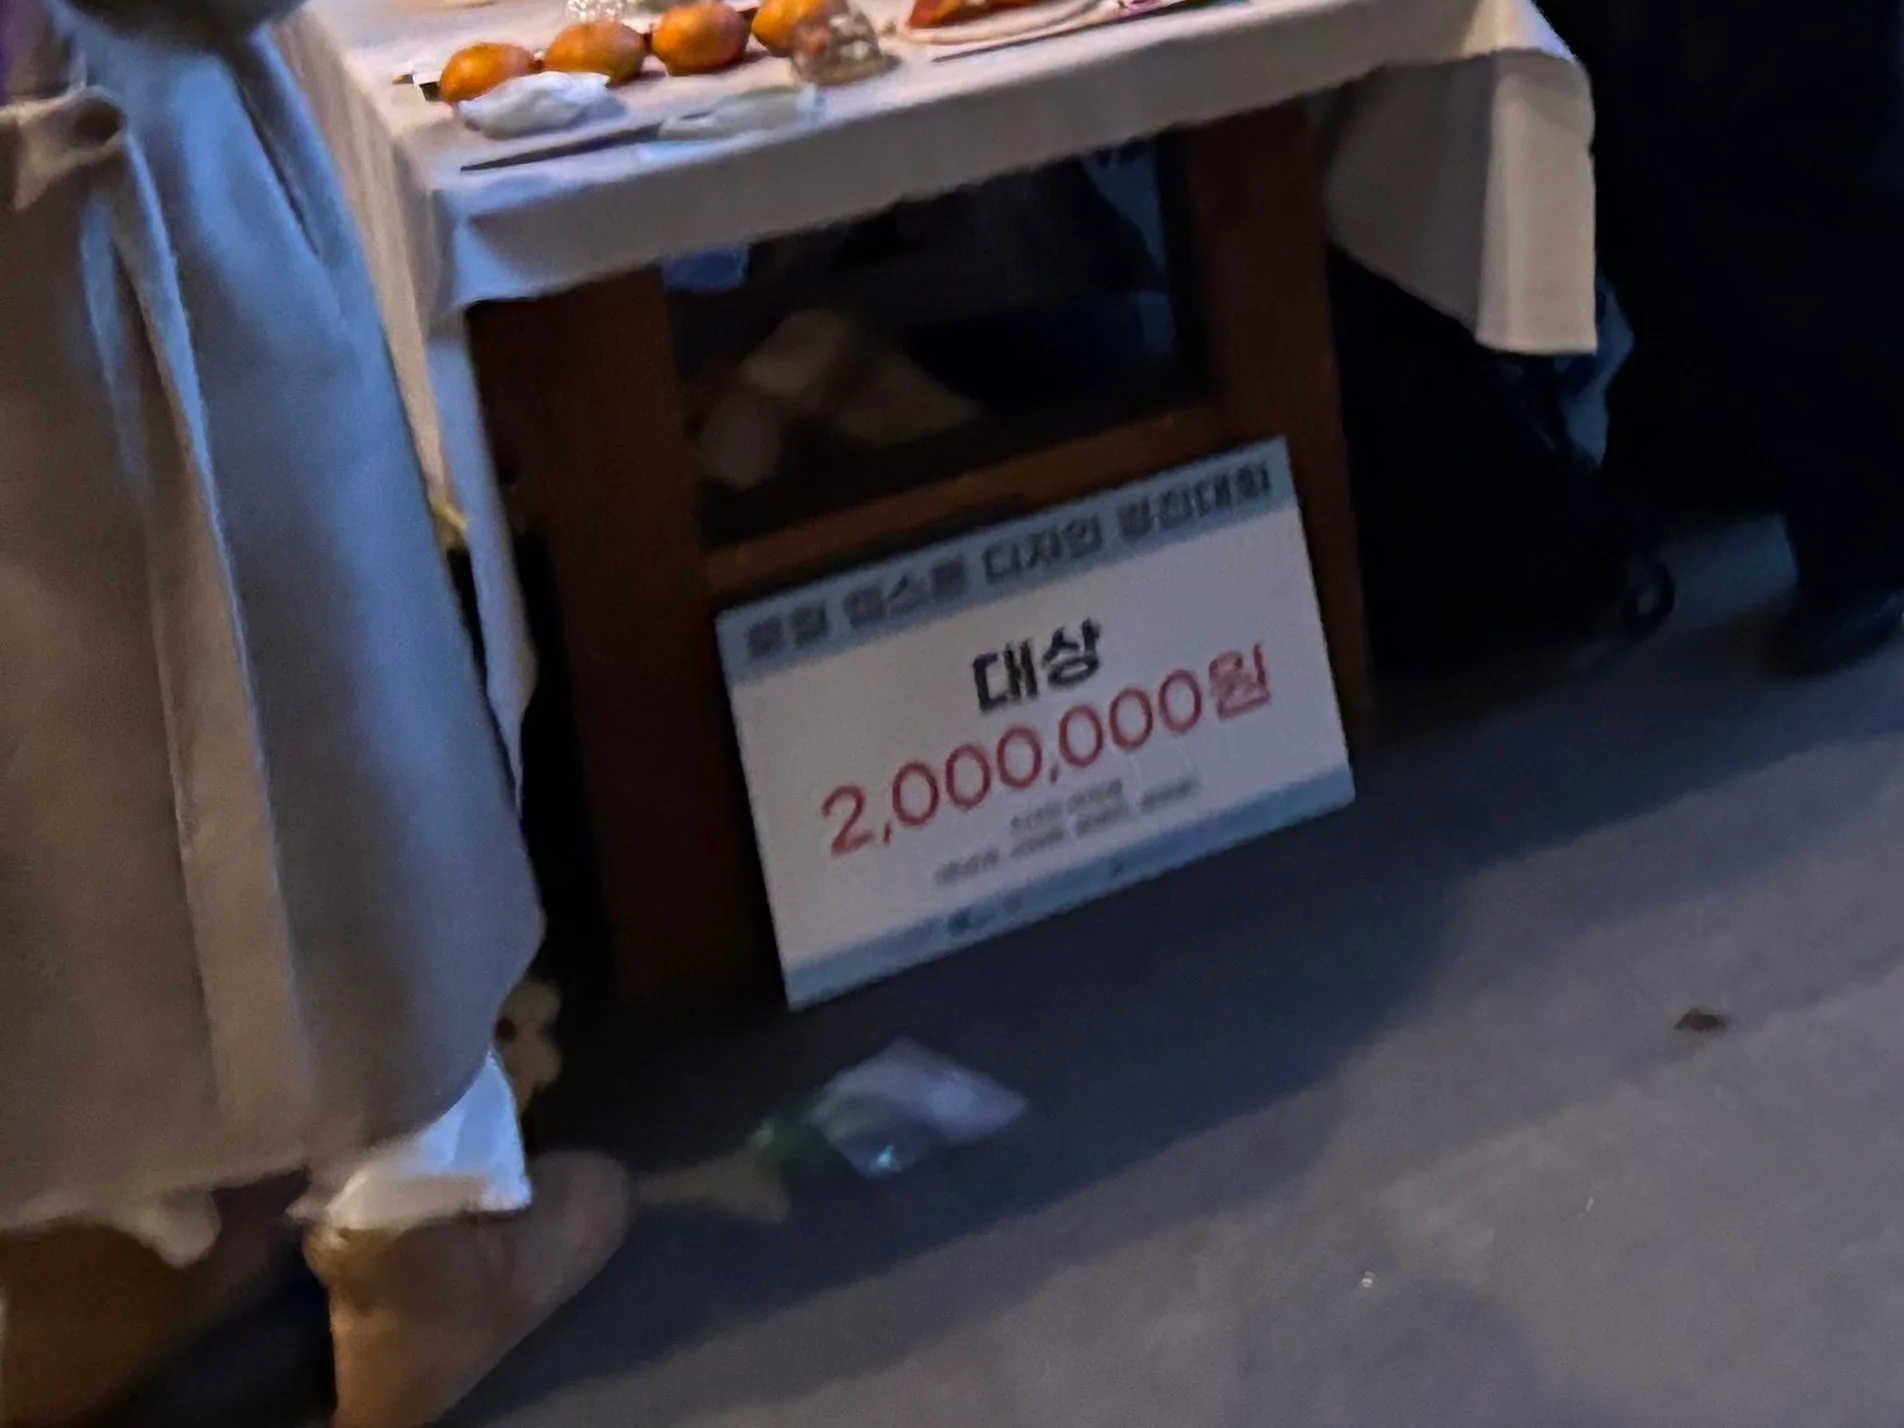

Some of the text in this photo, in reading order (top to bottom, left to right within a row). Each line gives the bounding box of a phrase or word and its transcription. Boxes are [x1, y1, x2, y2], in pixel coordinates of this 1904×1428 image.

[982, 516, 1103, 586] 디자인
[970, 617, 1103, 716] 대상
[820, 642, 1272, 859] 2,000,000원
